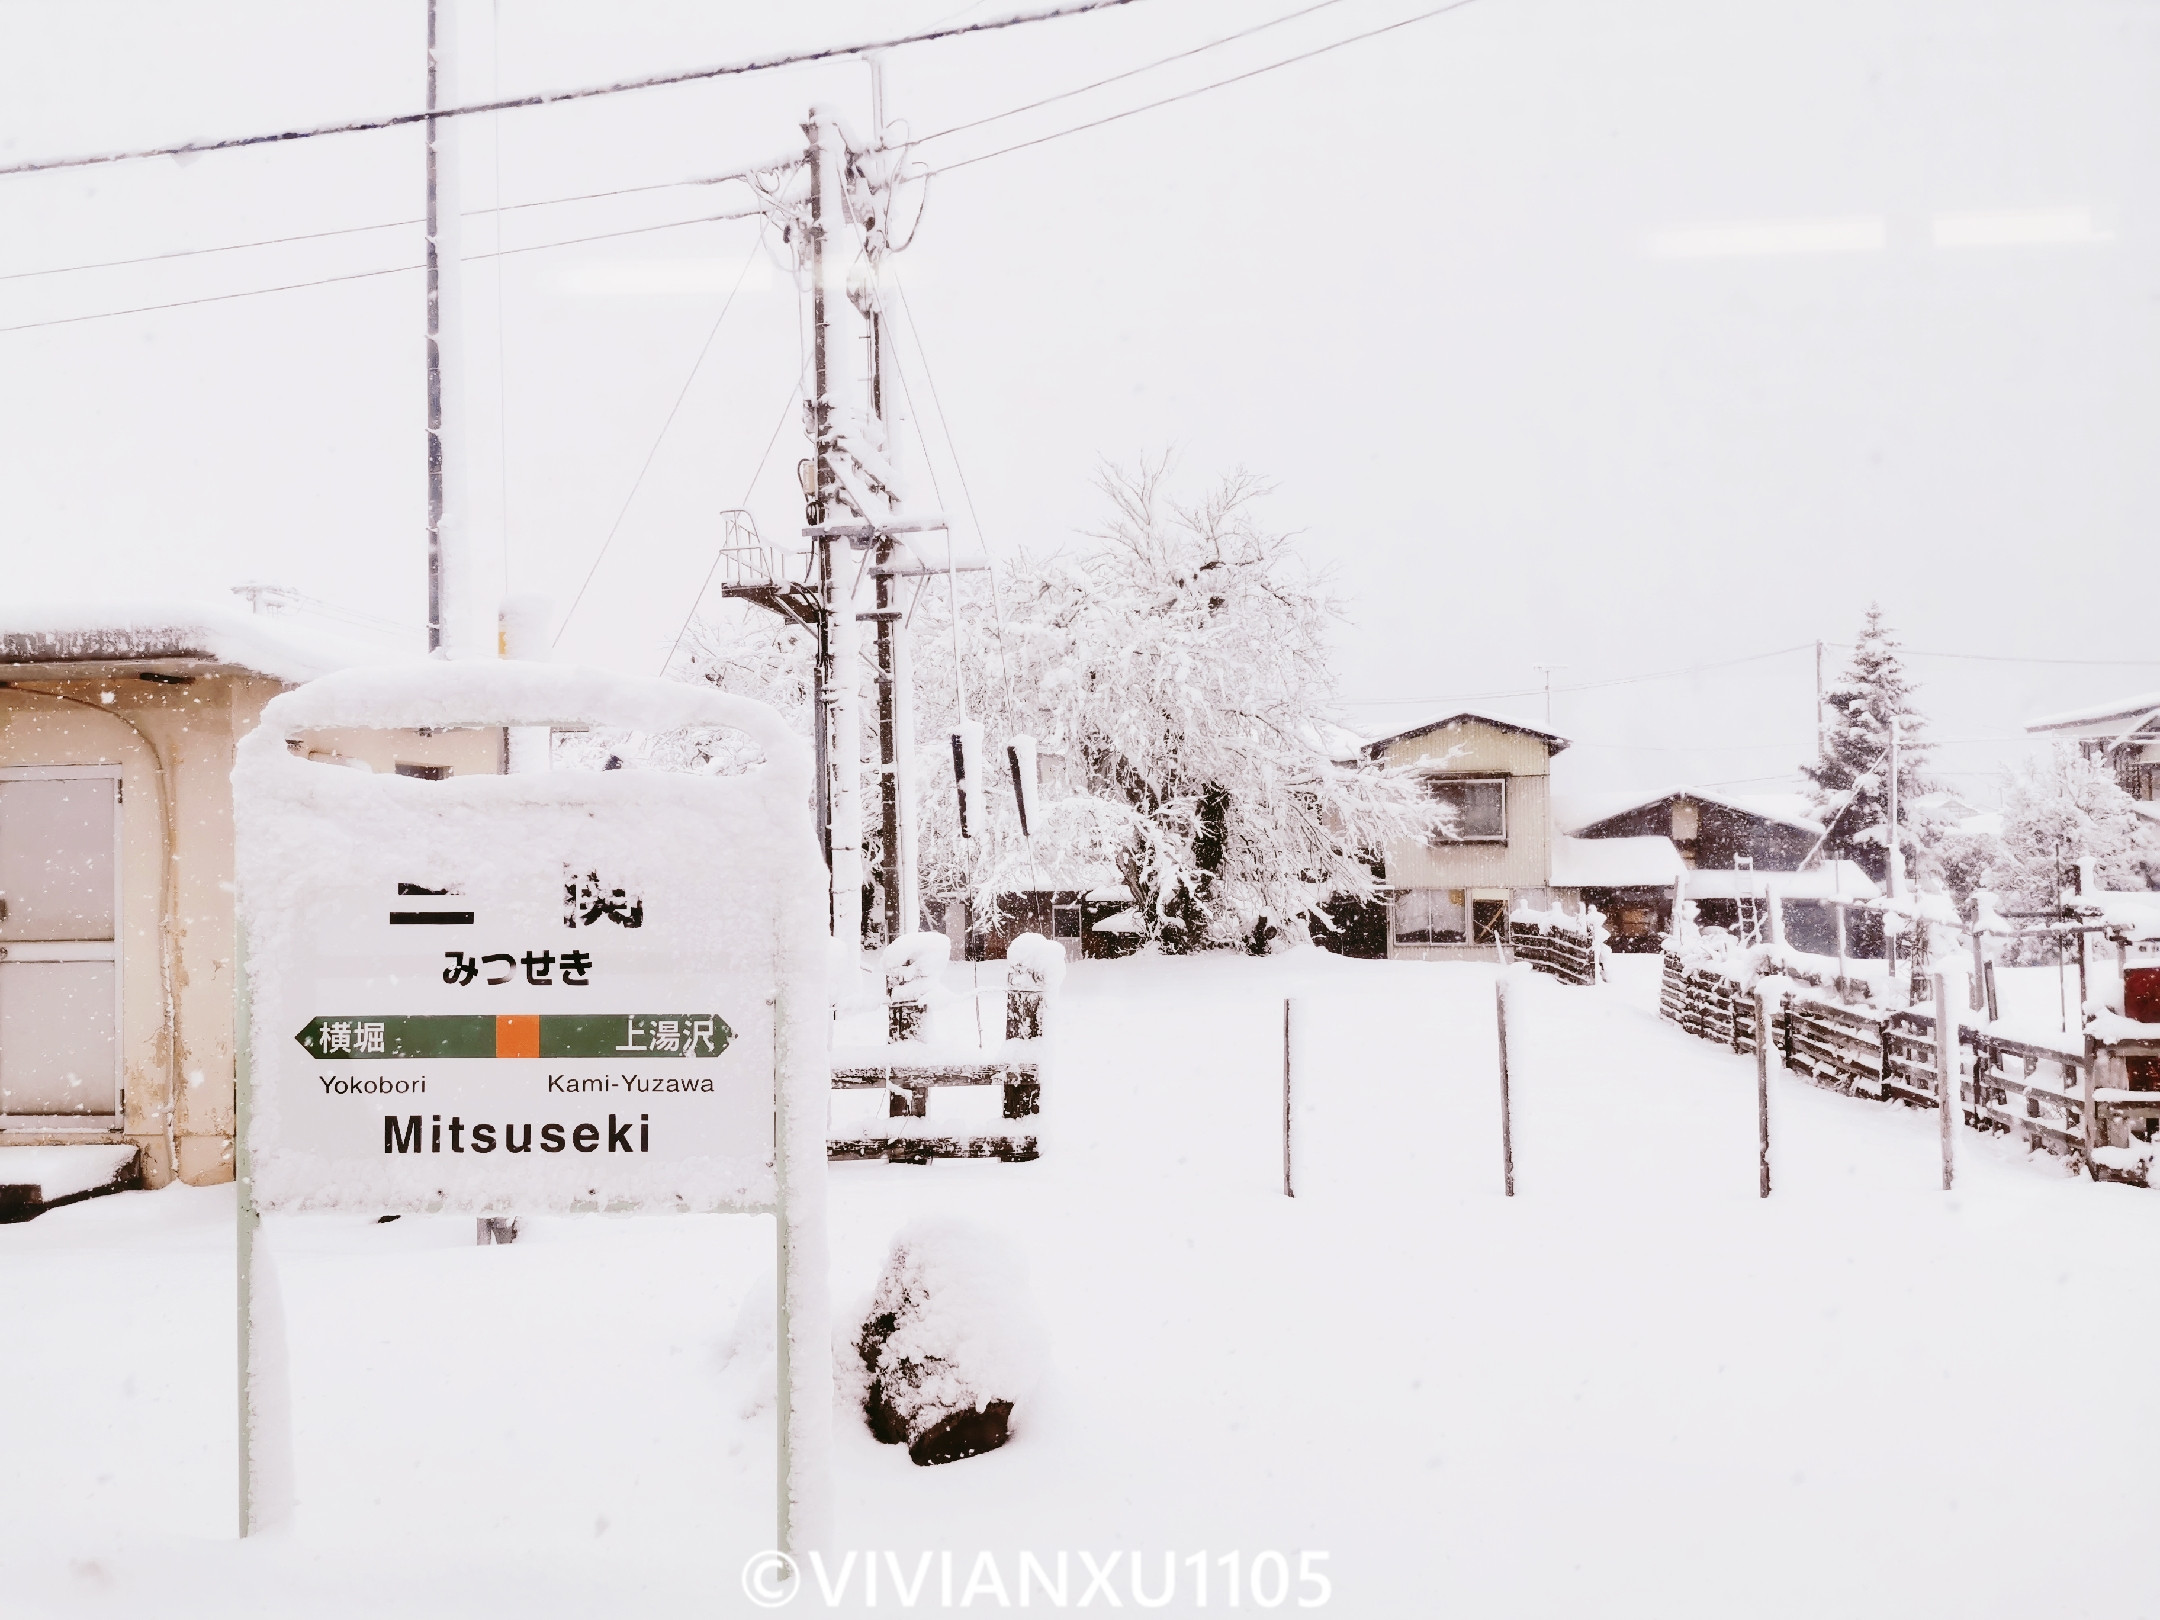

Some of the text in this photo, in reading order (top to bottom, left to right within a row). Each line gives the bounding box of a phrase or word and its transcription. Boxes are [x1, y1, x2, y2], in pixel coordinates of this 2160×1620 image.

[442, 949, 593, 987] みつせき
[320, 1022, 386, 1054] 横堀
[616, 1019, 715, 1054] 上湯沢
[320, 1075, 427, 1095] Yokobori
[548, 1074, 716, 1093] Kami-Yuzawa
[385, 1113, 649, 1154] Mitsuseki
